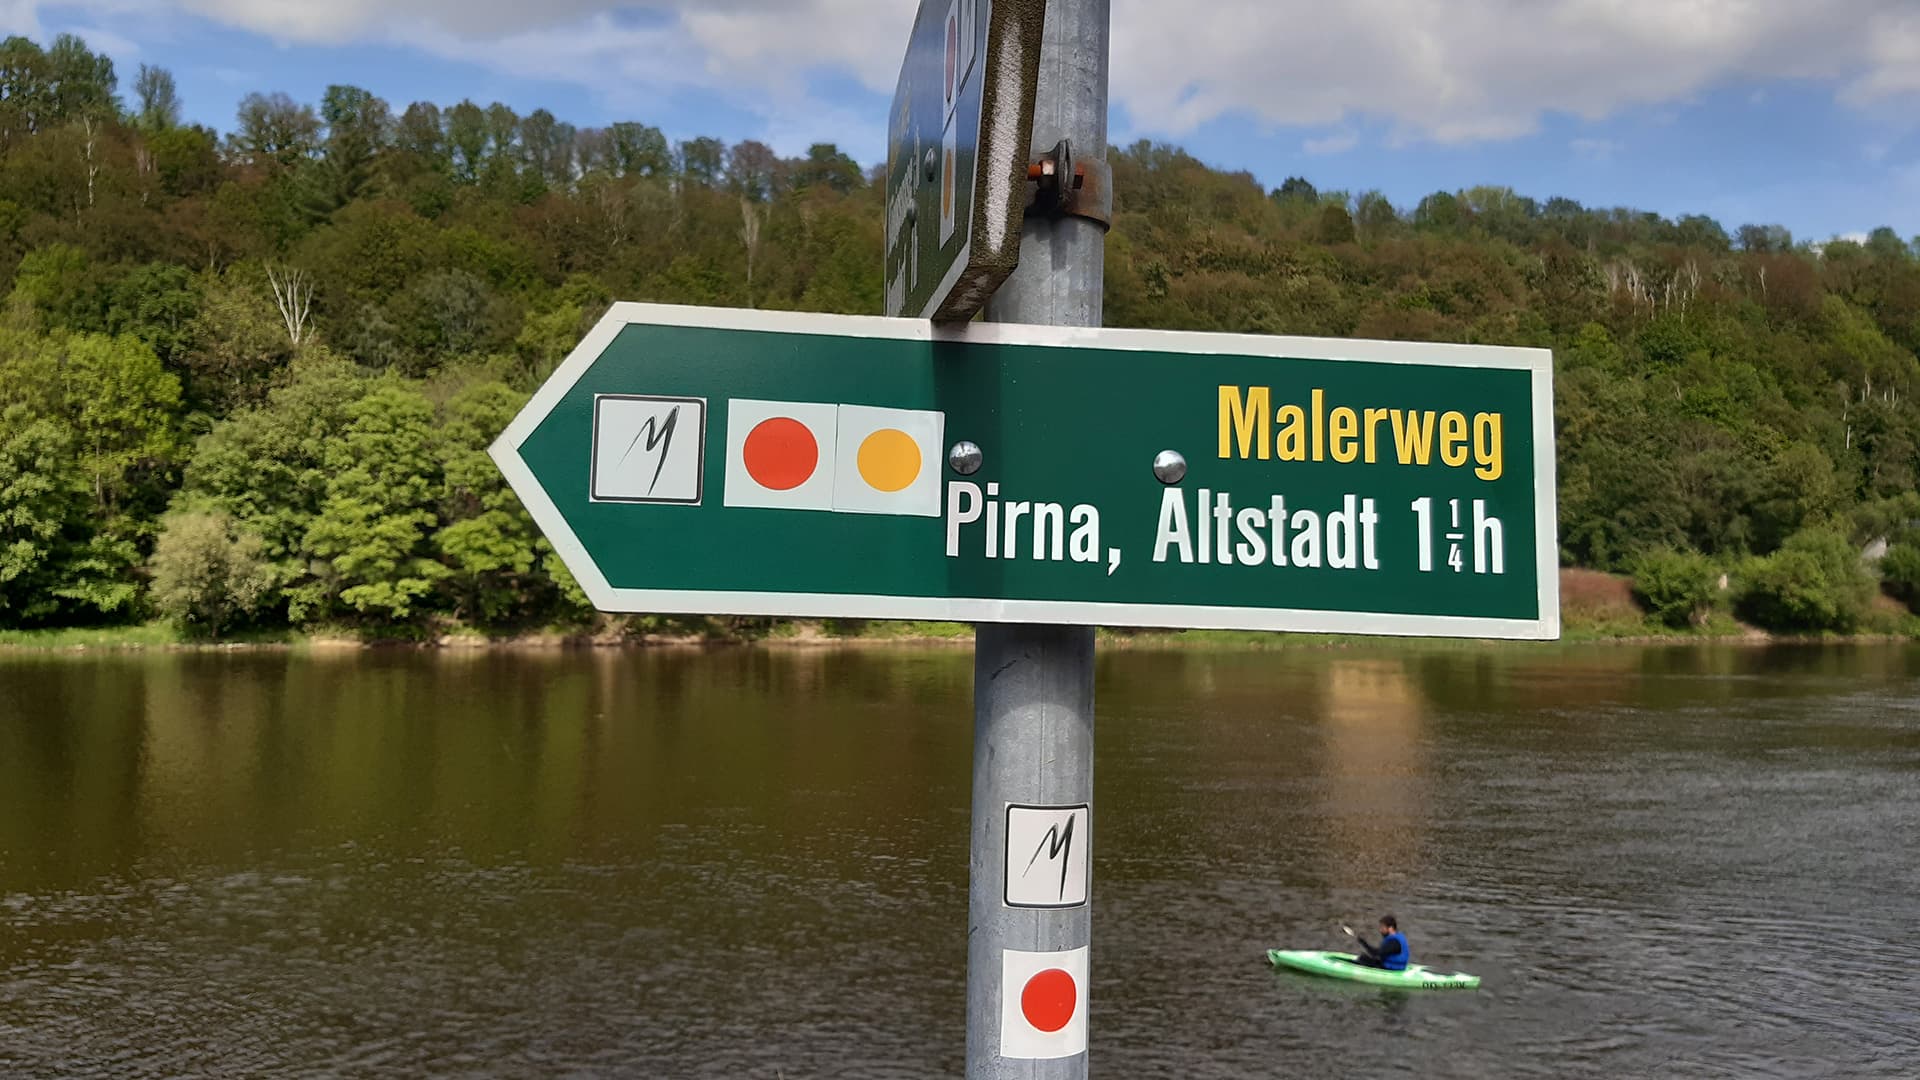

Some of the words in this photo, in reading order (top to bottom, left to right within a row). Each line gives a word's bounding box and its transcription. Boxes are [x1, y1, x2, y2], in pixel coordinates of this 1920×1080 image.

[1217, 385, 1503, 481] Malerweg
[945, 480, 1121, 577] Pirna,
[1153, 486, 1380, 572] Altstadt
